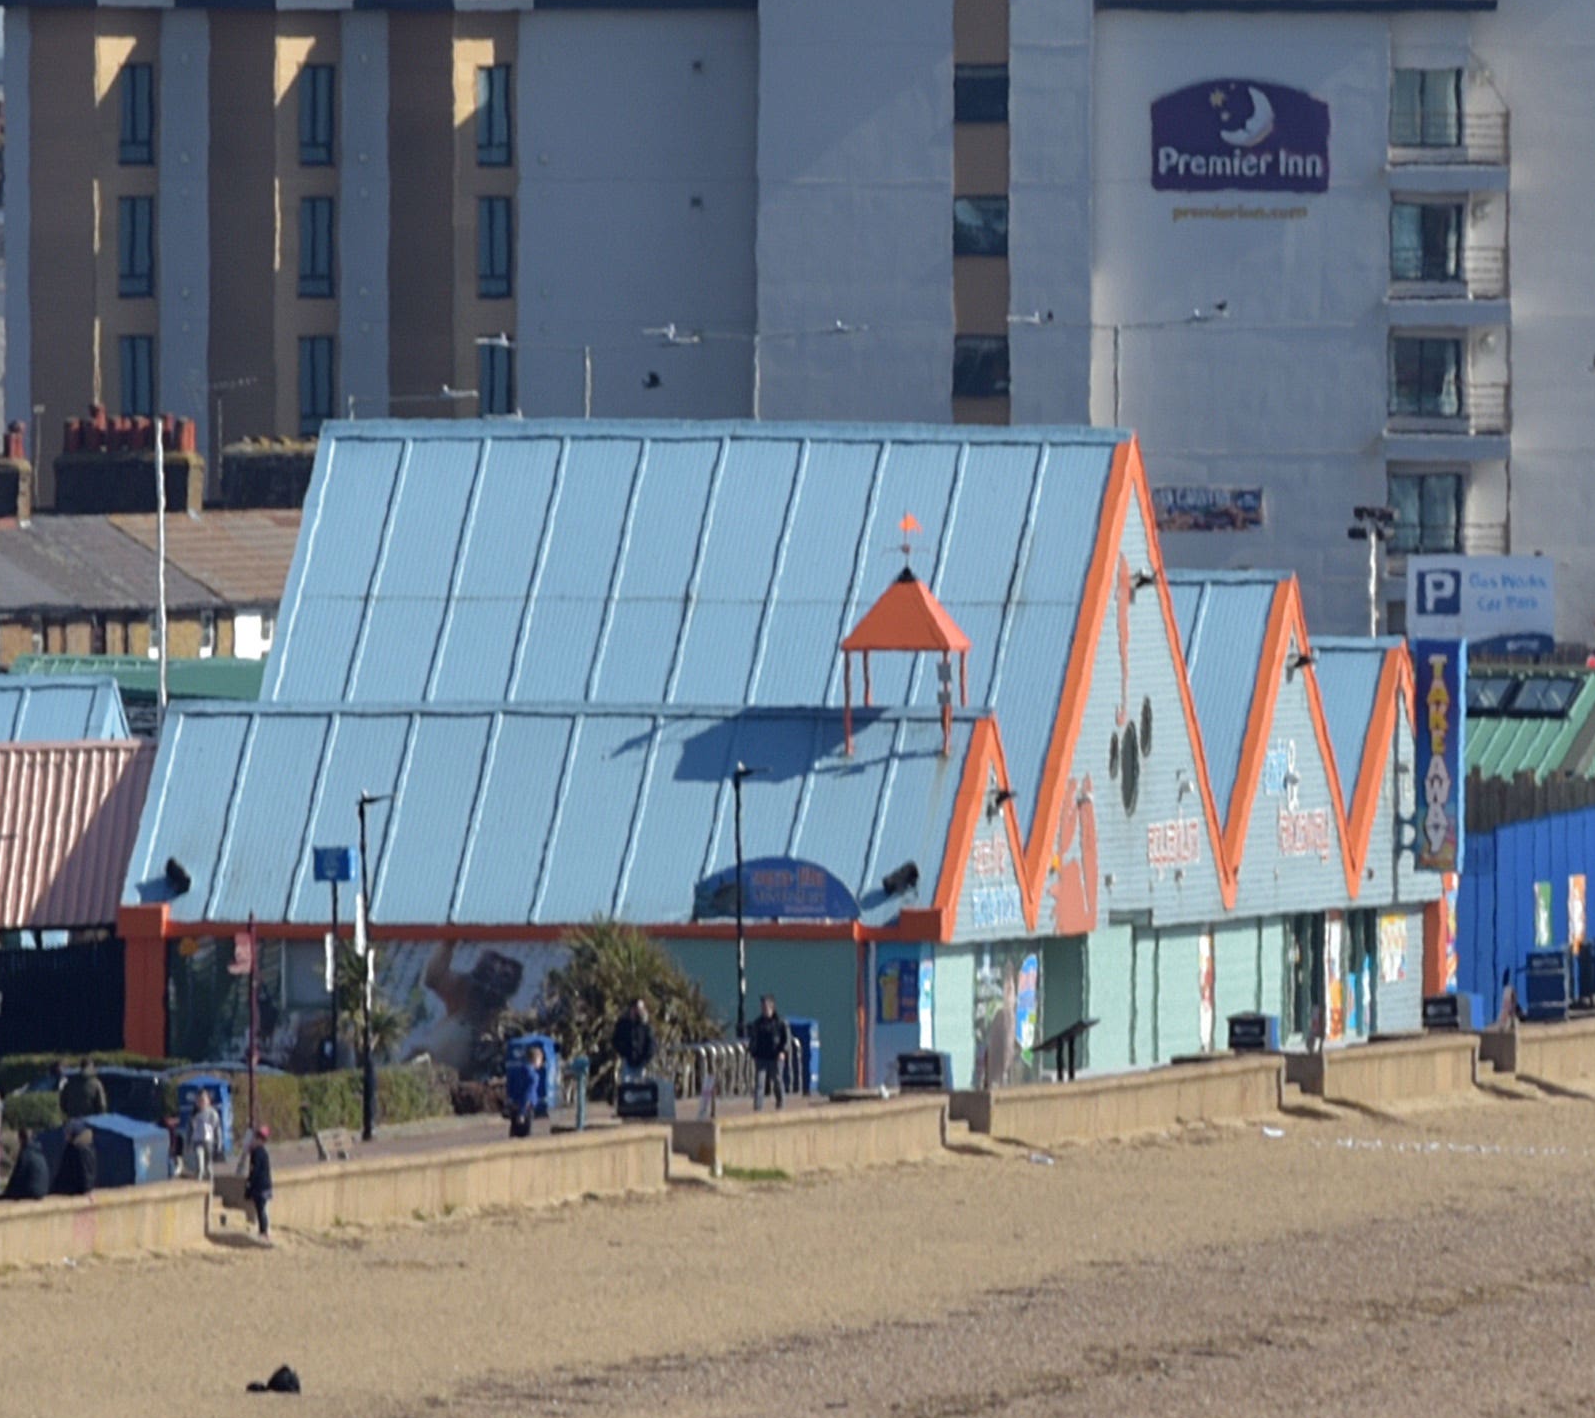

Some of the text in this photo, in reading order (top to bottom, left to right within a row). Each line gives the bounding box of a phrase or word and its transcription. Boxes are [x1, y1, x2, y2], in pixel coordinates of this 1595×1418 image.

[1158, 146, 1323, 177] Premier Inn
[1425, 573, 1455, 612] P
